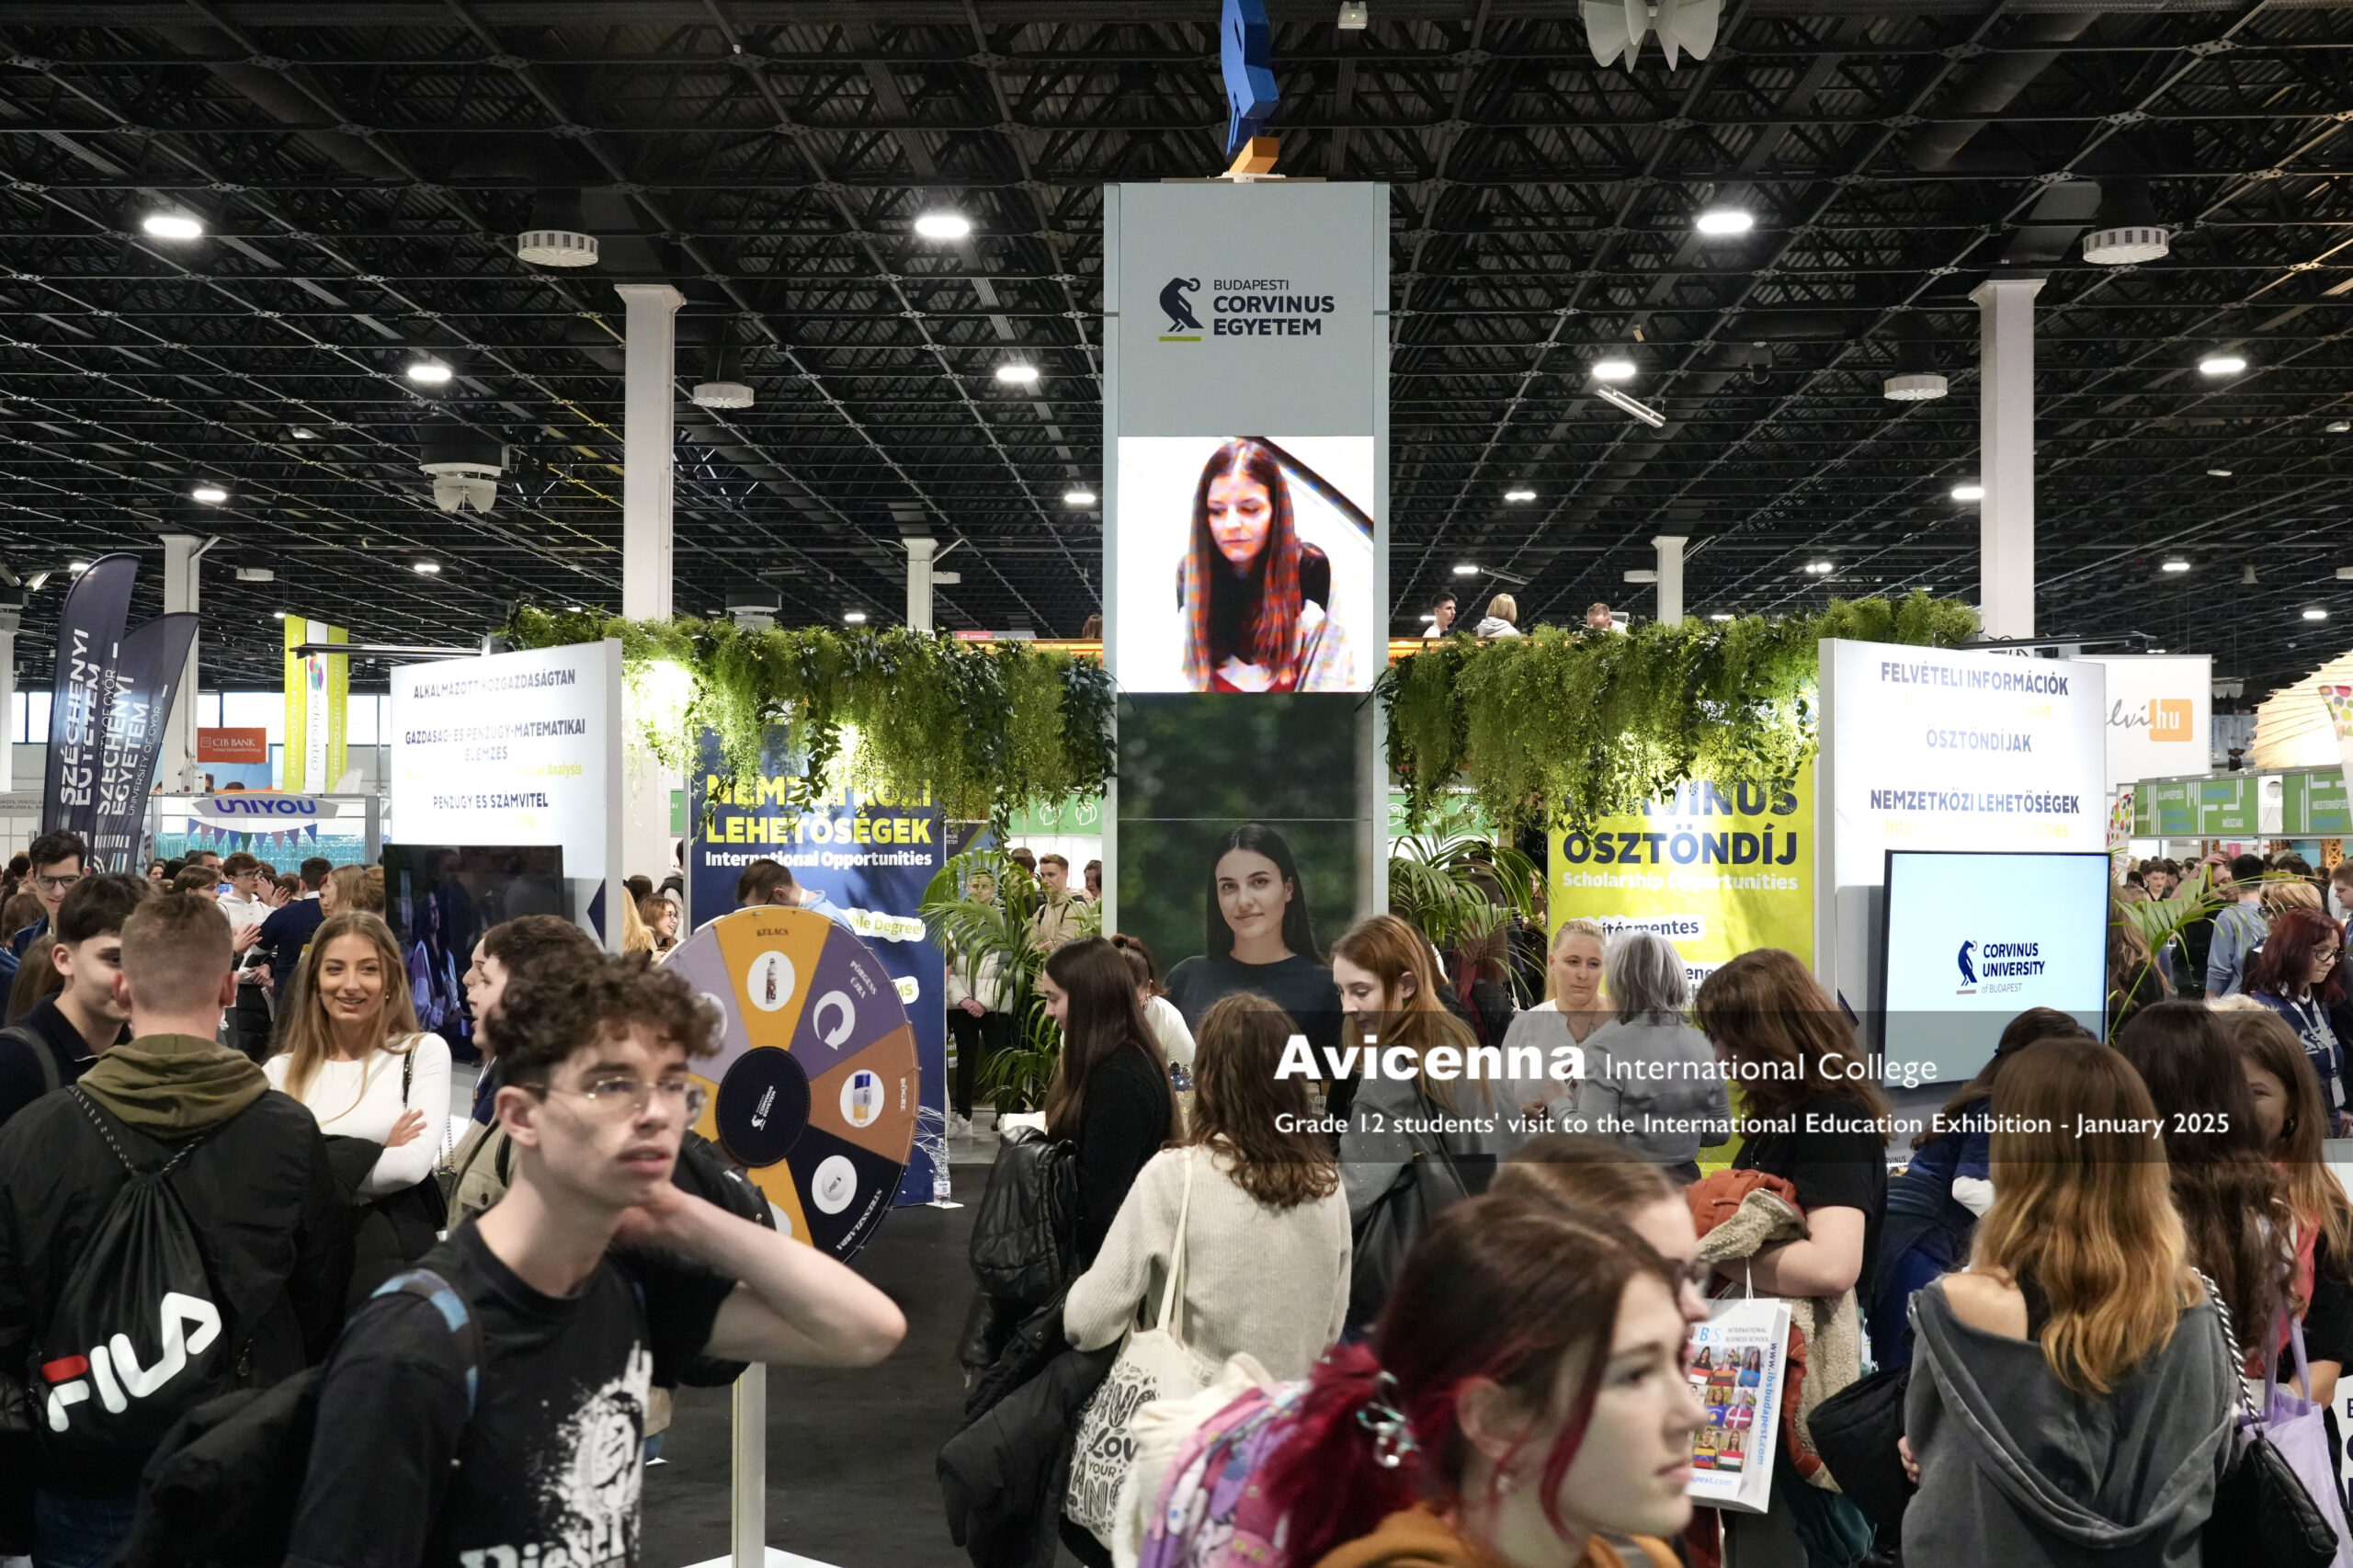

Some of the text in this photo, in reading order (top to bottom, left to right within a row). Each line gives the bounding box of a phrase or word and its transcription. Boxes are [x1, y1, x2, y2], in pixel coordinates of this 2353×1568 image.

[1214, 279, 1289, 290] BUDAPESTI
[1213, 295, 1335, 312] CORVINUS
[1214, 318, 1321, 335] EGYETEM
[1881, 660, 2069, 696] FELVÉTELI INFORMÁCIÓK
[414, 679, 479, 699] ALKALMAZOTT
[61, 629, 89, 806] SZÉCHENYI
[212, 738, 256, 746] CIB BANK
[1927, 724, 2031, 753] ÖSZTÖNDÍJAK
[111, 703, 150, 815] EGYETEM
[547, 762, 582, 778] Analysis
[491, 790, 549, 809] SZÁMVITEL
[1870, 786, 1972, 812] NEMZETKÖZI
[1563, 822, 1798, 864] ÖSZTÖNDÍJ
[821, 851, 931, 869] Opportunities
[1563, 870, 1799, 891] Scholarship Opportunities
[756, 927, 789, 937] KULACS
[874, 917, 920, 937] Degree
[1984, 942, 2039, 959] CORVINUS
[1983, 960, 2045, 977] UNIVERSITY
[1982, 983, 2022, 993] of BUDAPEST
[41, 1292, 222, 1433] FILA
[1757, 1342, 1778, 1466] www.ibsbudapest.com
[1087, 1460, 1117, 1478] YOUR
